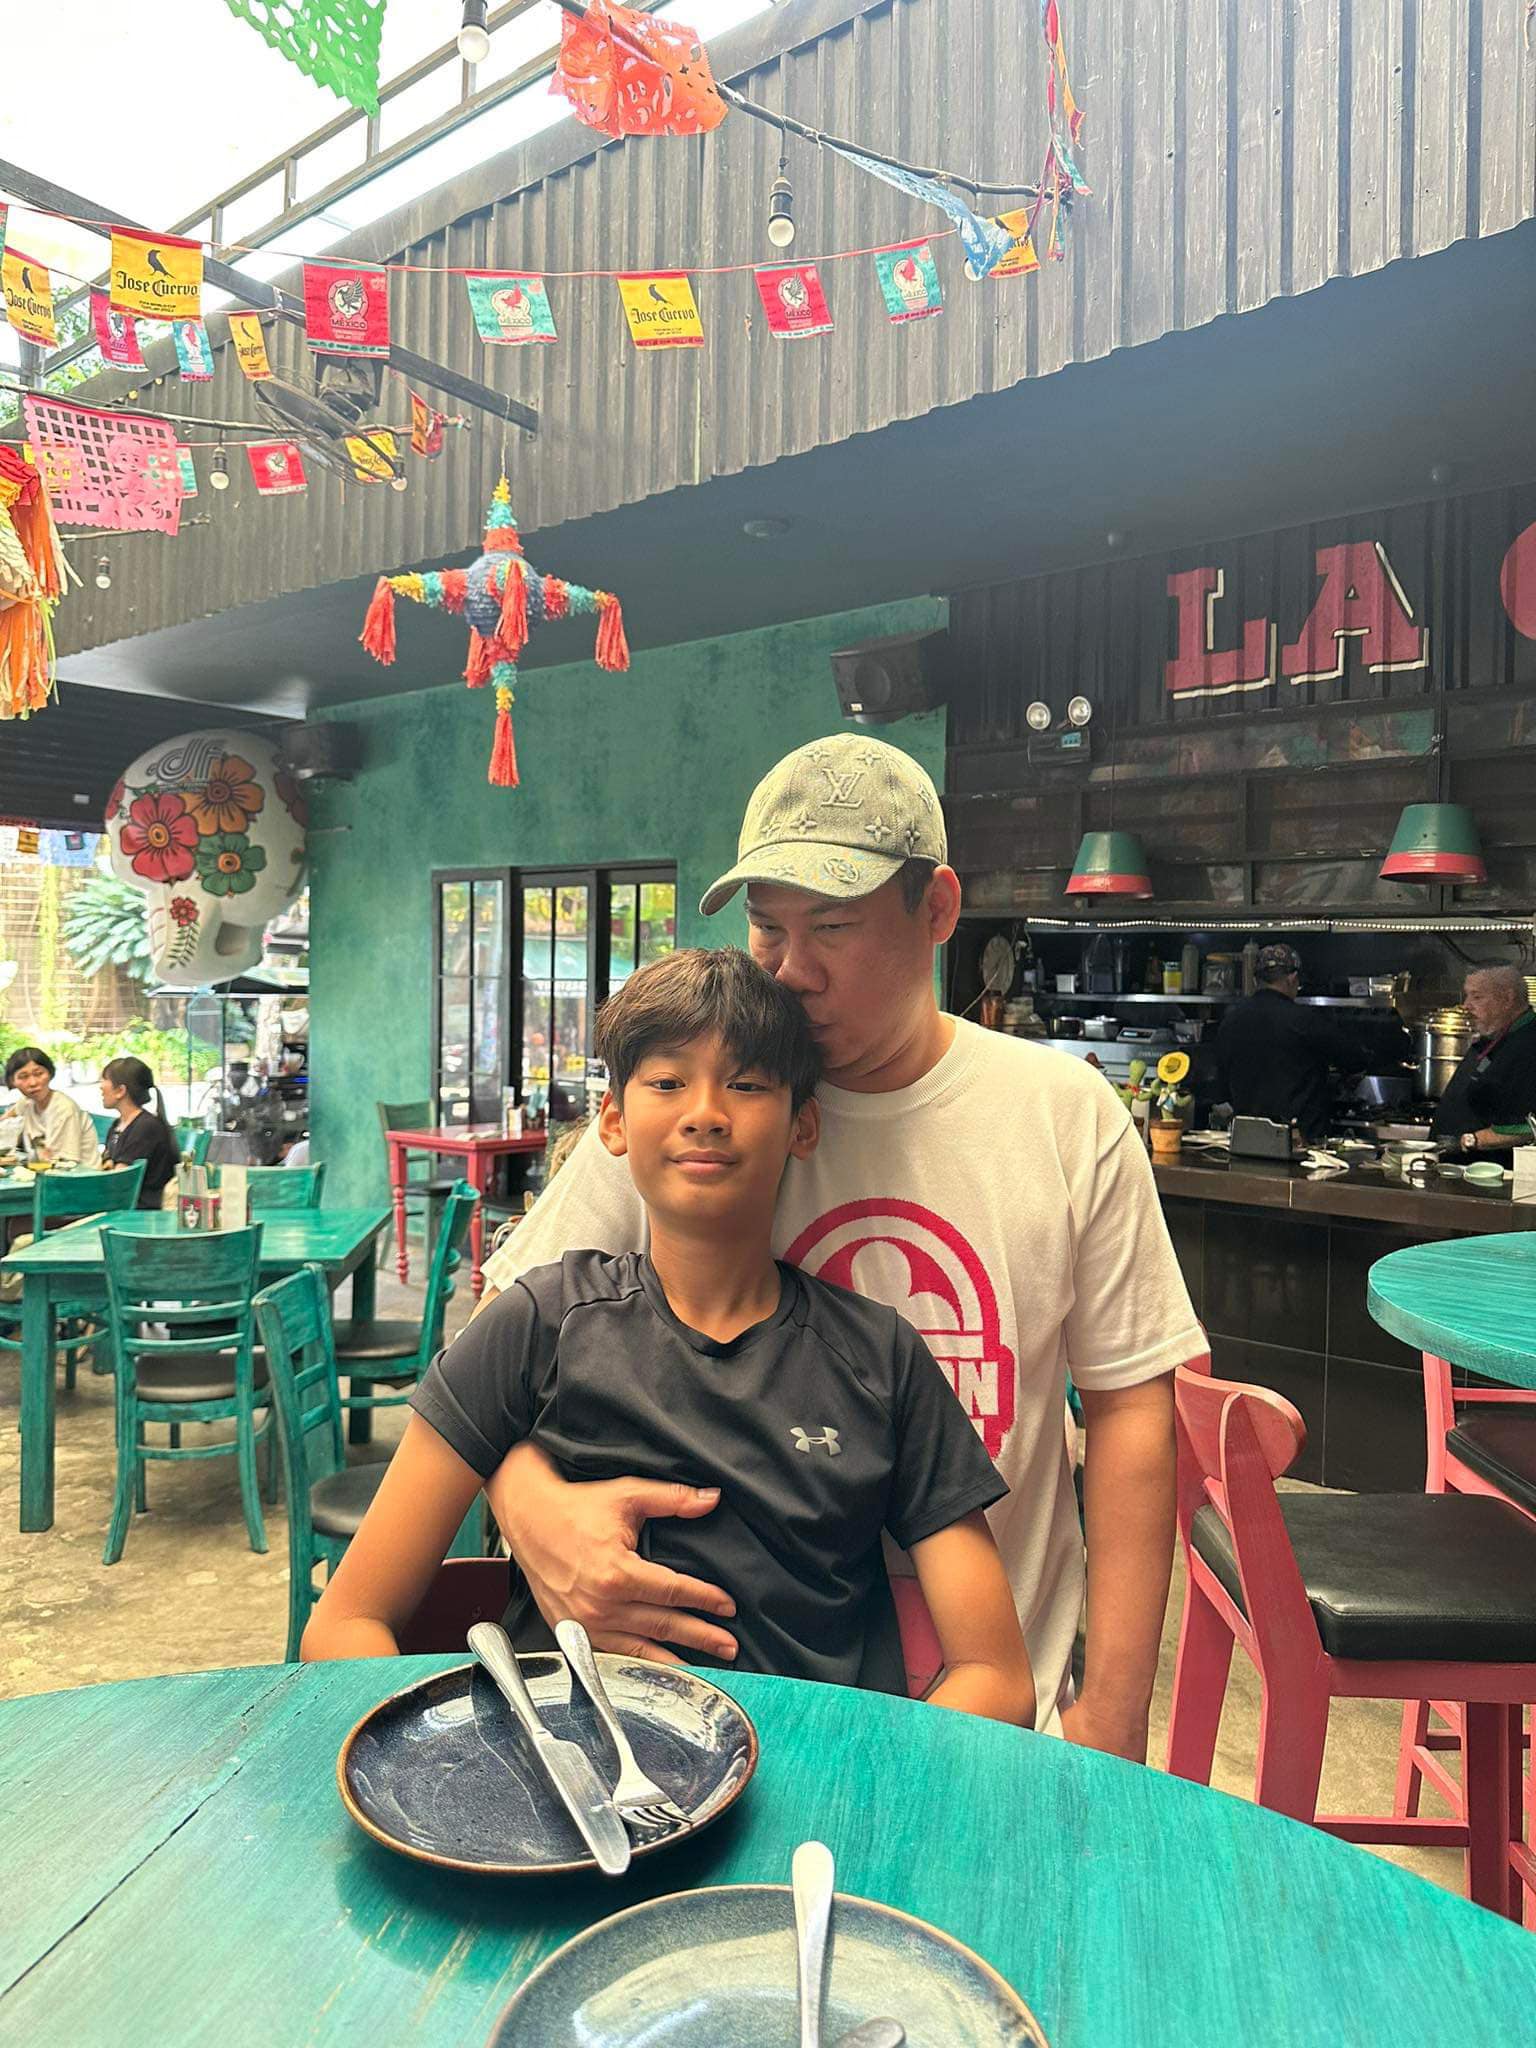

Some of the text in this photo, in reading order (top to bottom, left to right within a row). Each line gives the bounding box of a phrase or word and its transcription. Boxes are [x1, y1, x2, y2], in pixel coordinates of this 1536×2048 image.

[115, 270, 199, 297] Jose Cuervo
[6, 287, 52, 319] Jose Cuervo
[630, 306, 695, 325] Jose Cuervo
[1164, 540, 1430, 700] LA
[820, 767, 866, 810] LV
